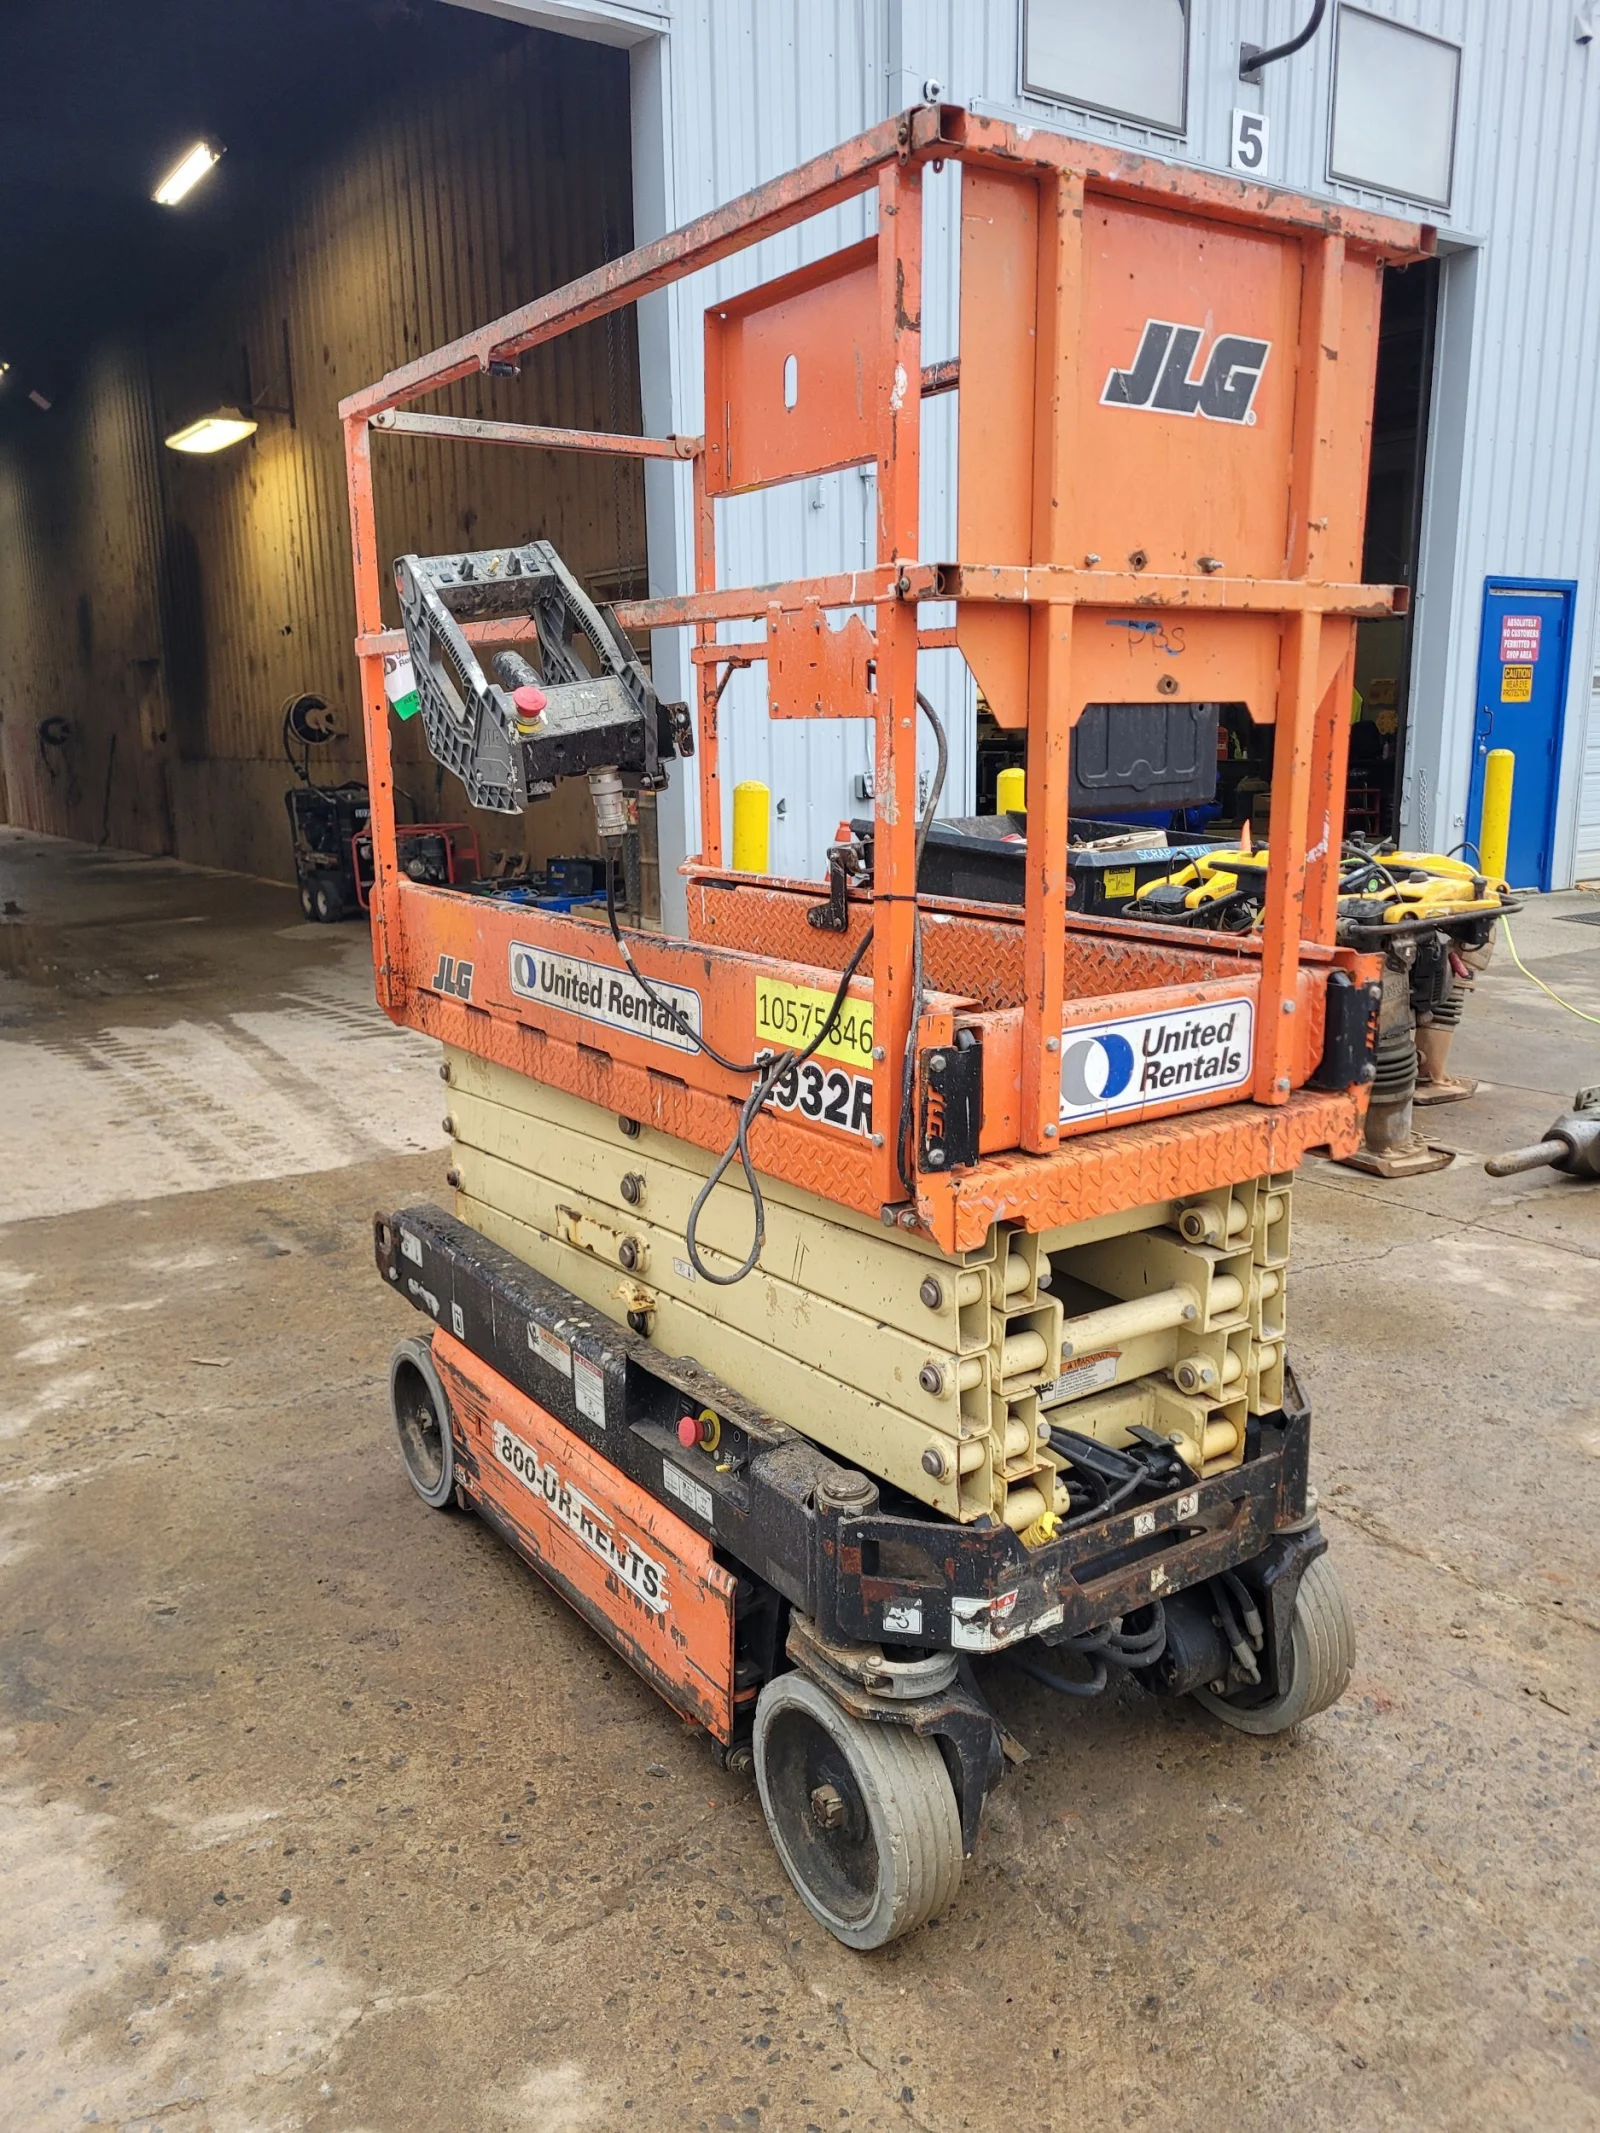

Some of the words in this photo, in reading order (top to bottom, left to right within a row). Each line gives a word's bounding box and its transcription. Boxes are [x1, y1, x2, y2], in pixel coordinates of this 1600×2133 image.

[1238, 115, 1263, 168] 5
[1101, 319, 1268, 424] JLG
[1503, 629, 1511, 637] NO
[1511, 629, 1540, 638] CUSTOMERS
[1504, 640, 1530, 649] PERMITTED
[1530, 640, 1537, 648] IN
[1507, 618, 1538, 627] ABSOLUTELY
[1504, 668, 1531, 678] CAUTION
[1506, 650, 1519, 659] SHOP
[1519, 651, 1533, 659] AREA
[1136, 848, 1171, 861] SCRAP
[433, 954, 473, 1000] JLG
[540, 961, 602, 1009] United
[608, 980, 690, 1036] Rentals
[759, 993, 873, 1054] 10575846
[1142, 1013, 1236, 1058] United
[1139, 1047, 1242, 1092] Rentals
